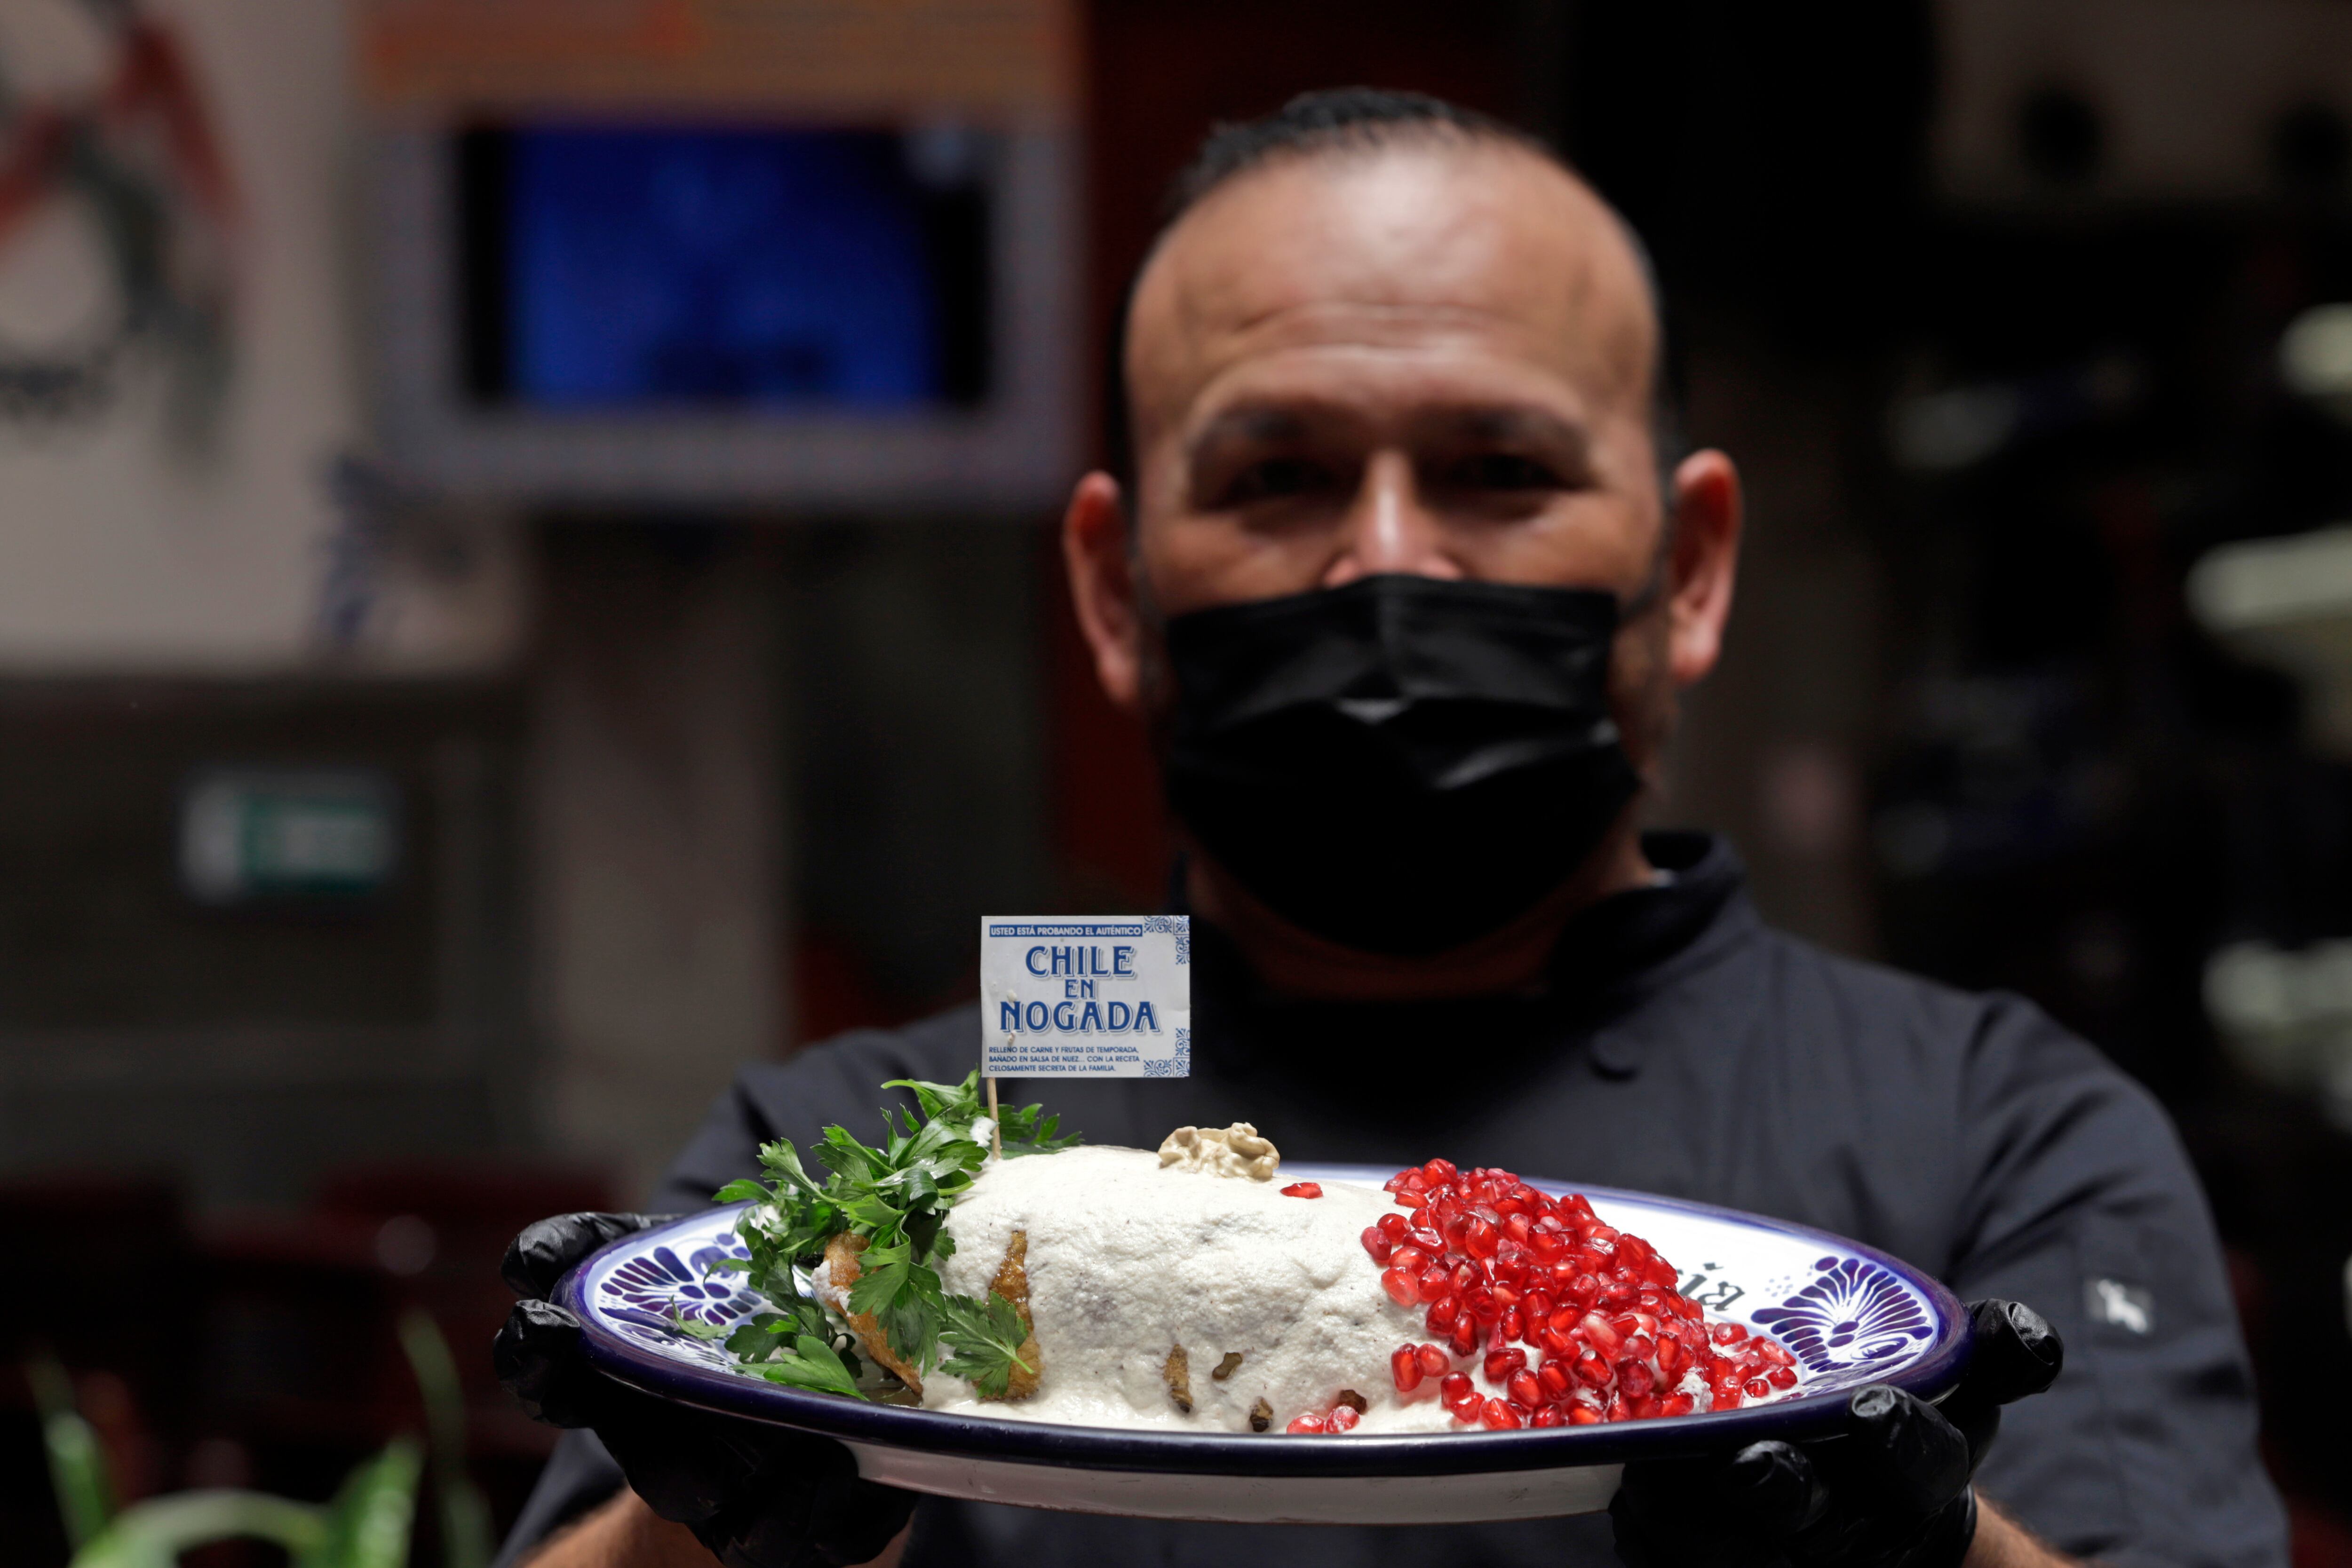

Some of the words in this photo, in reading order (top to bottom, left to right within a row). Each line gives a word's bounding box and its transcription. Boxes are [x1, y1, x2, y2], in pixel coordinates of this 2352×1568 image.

[991, 927, 1015, 935] USTED
[1017, 925, 1036, 935] ESTÁ
[1037, 927, 1083, 935] PROBANDO
[1085, 927, 1094, 935] EL
[1096, 925, 1141, 935] AUTÉNTICO
[1025, 946, 1136, 978] CHILE
[1065, 979, 1096, 999] EN
[1000, 1001, 1160, 1033] NOGADA
